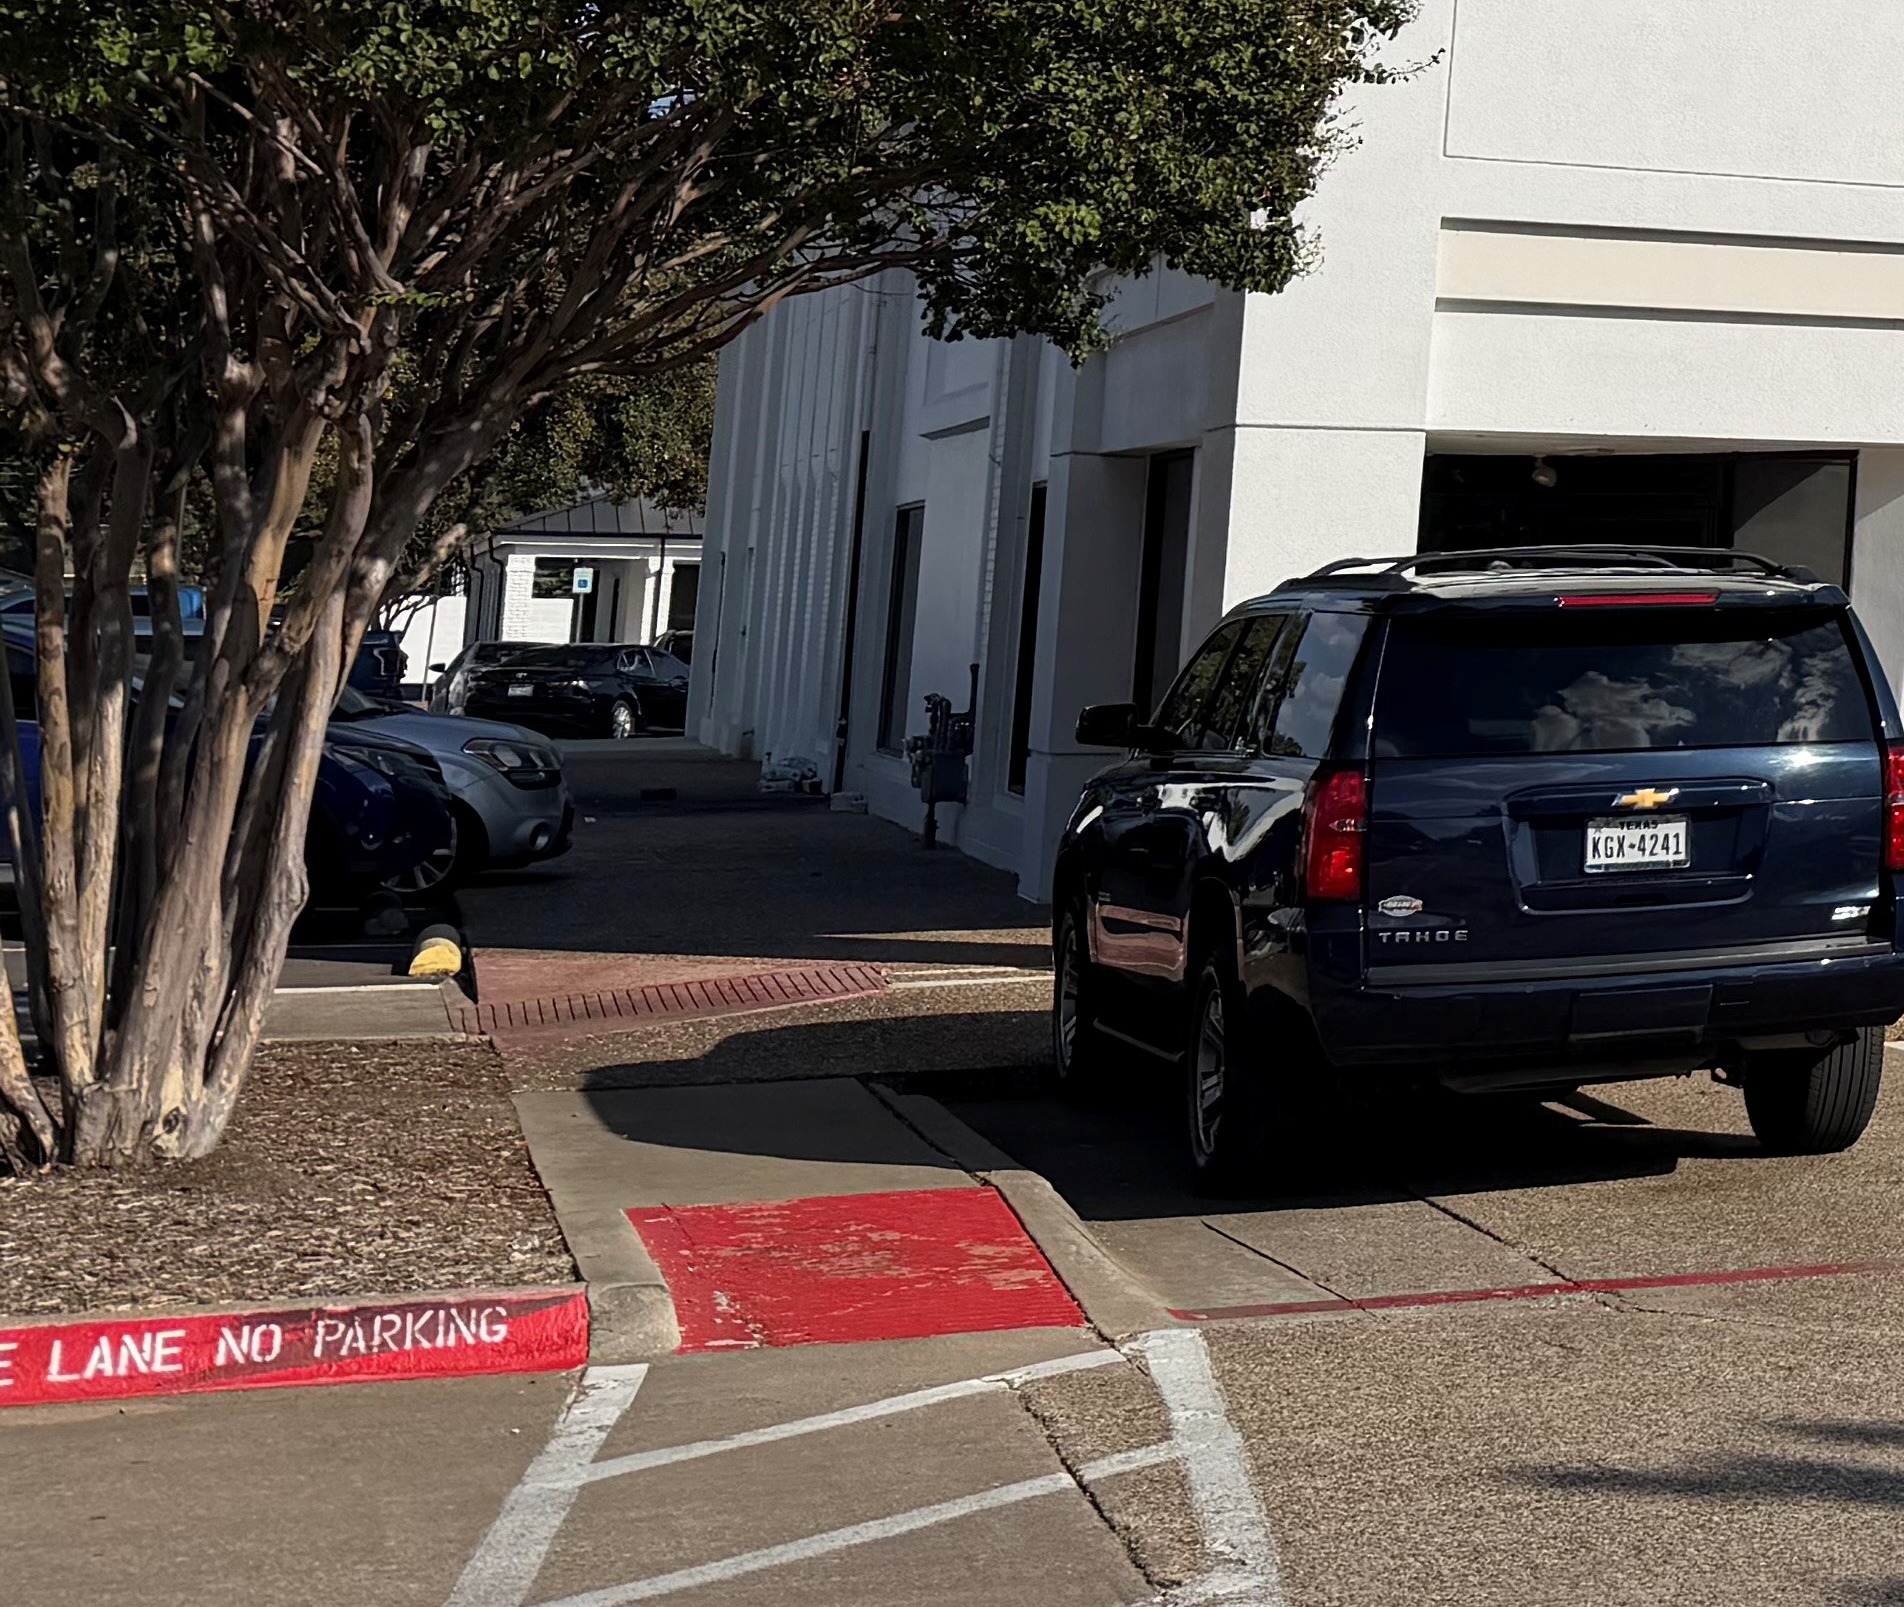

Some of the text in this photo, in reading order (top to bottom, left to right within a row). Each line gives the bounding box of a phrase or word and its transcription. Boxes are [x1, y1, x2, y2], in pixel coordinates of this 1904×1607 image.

[1378, 929, 1470, 944] TAHOE
[46, 1329, 187, 1382] LANE
[213, 1323, 283, 1367] NO
[313, 1305, 509, 1359] PARKING
